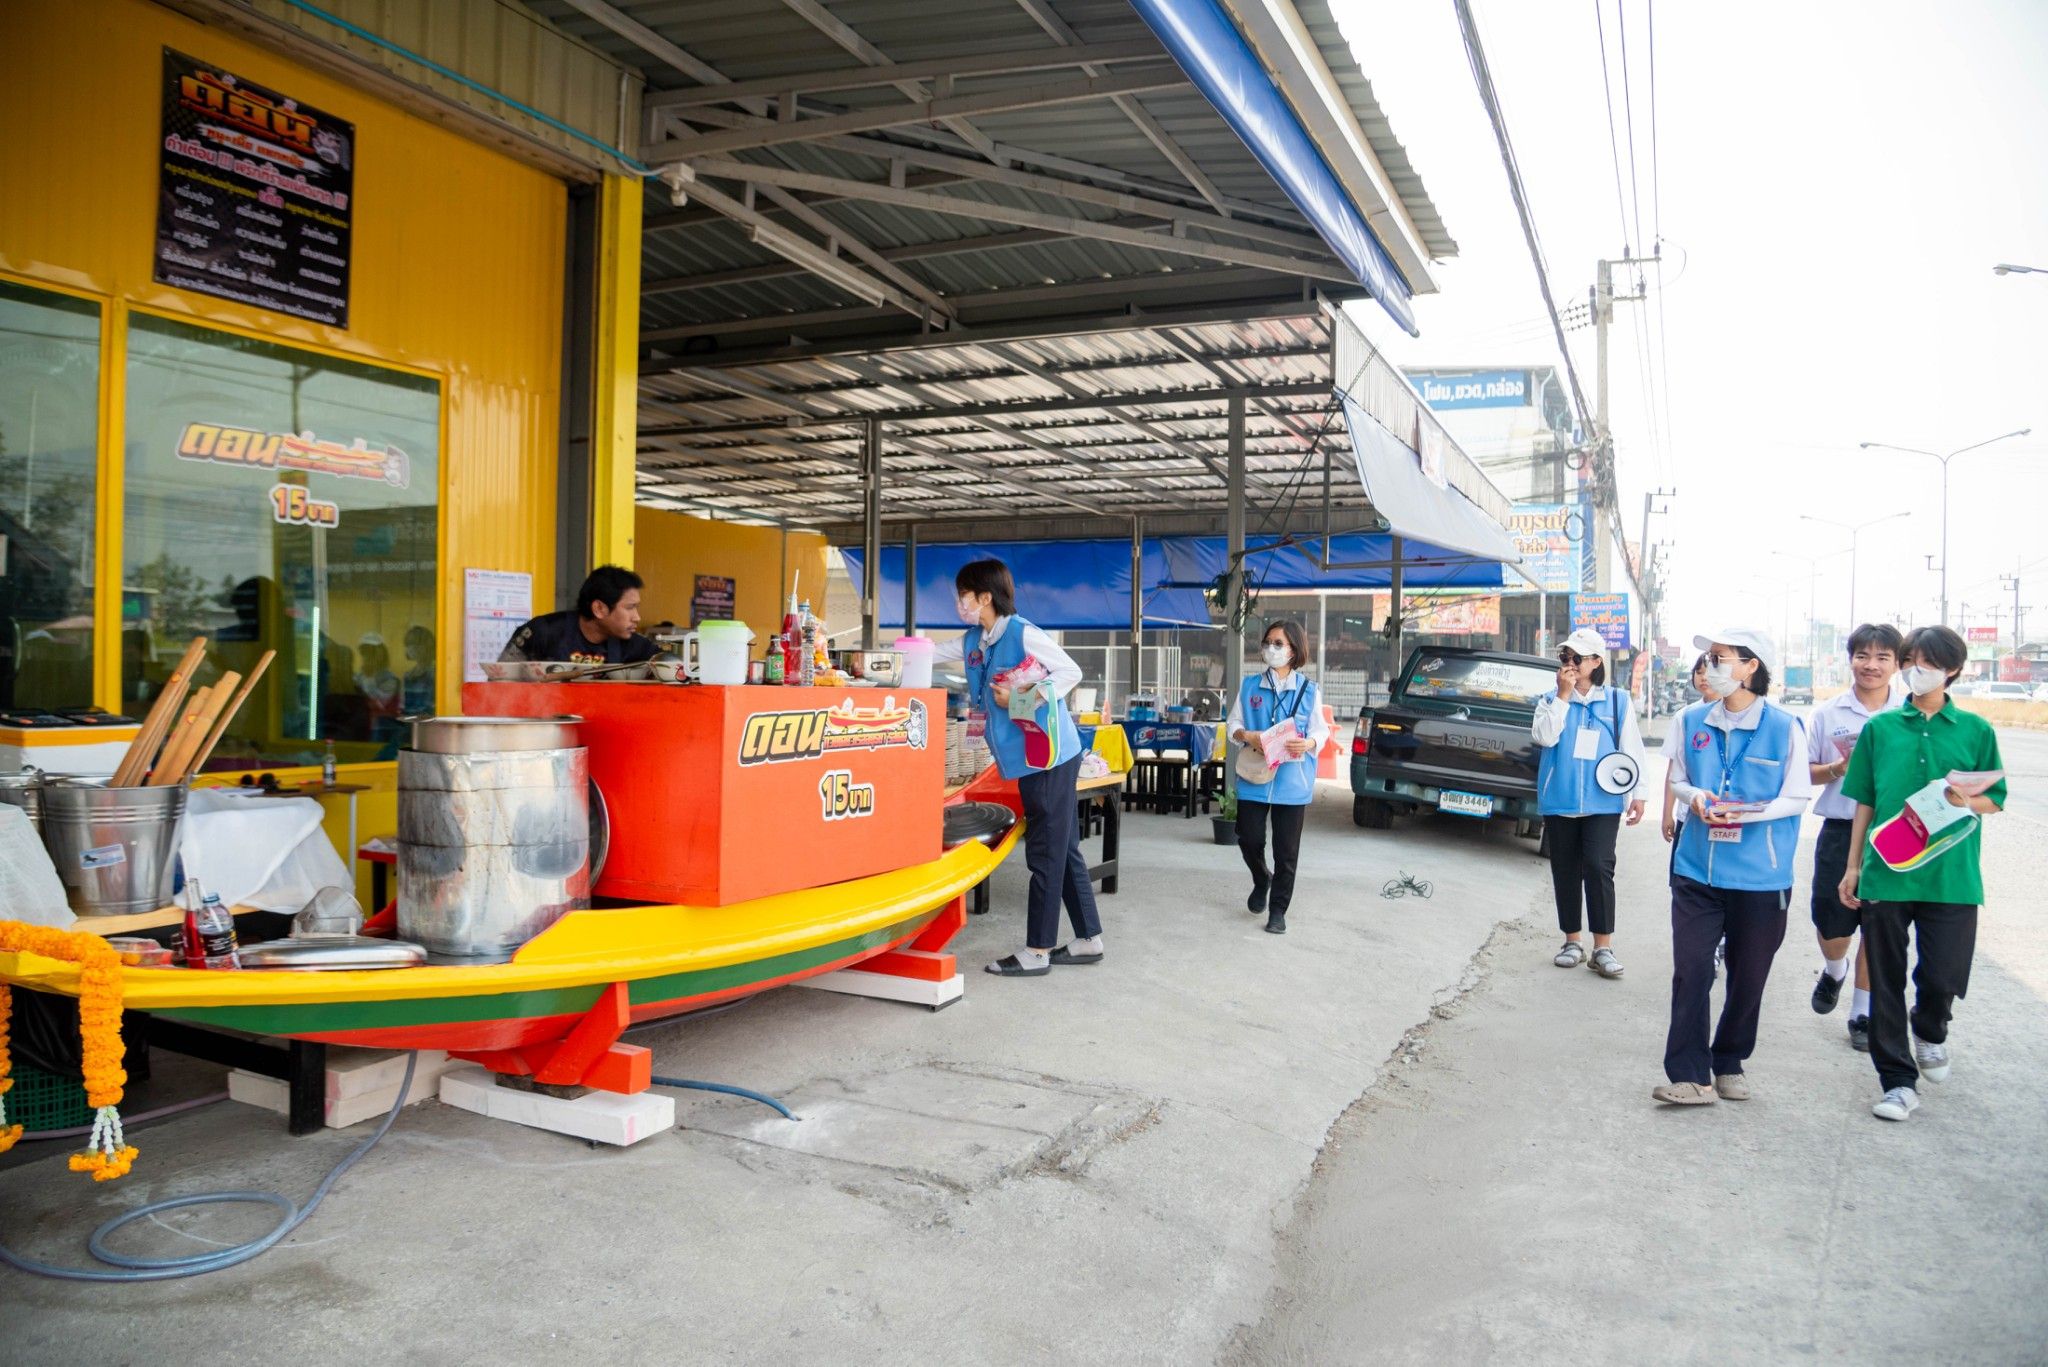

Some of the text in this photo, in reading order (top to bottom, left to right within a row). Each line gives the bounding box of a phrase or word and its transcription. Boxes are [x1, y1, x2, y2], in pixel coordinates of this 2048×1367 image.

[1442, 732, 1505, 752] ISUZU
[821, 774, 873, 818] 15บาท
[1712, 831, 1738, 839] STAFF
